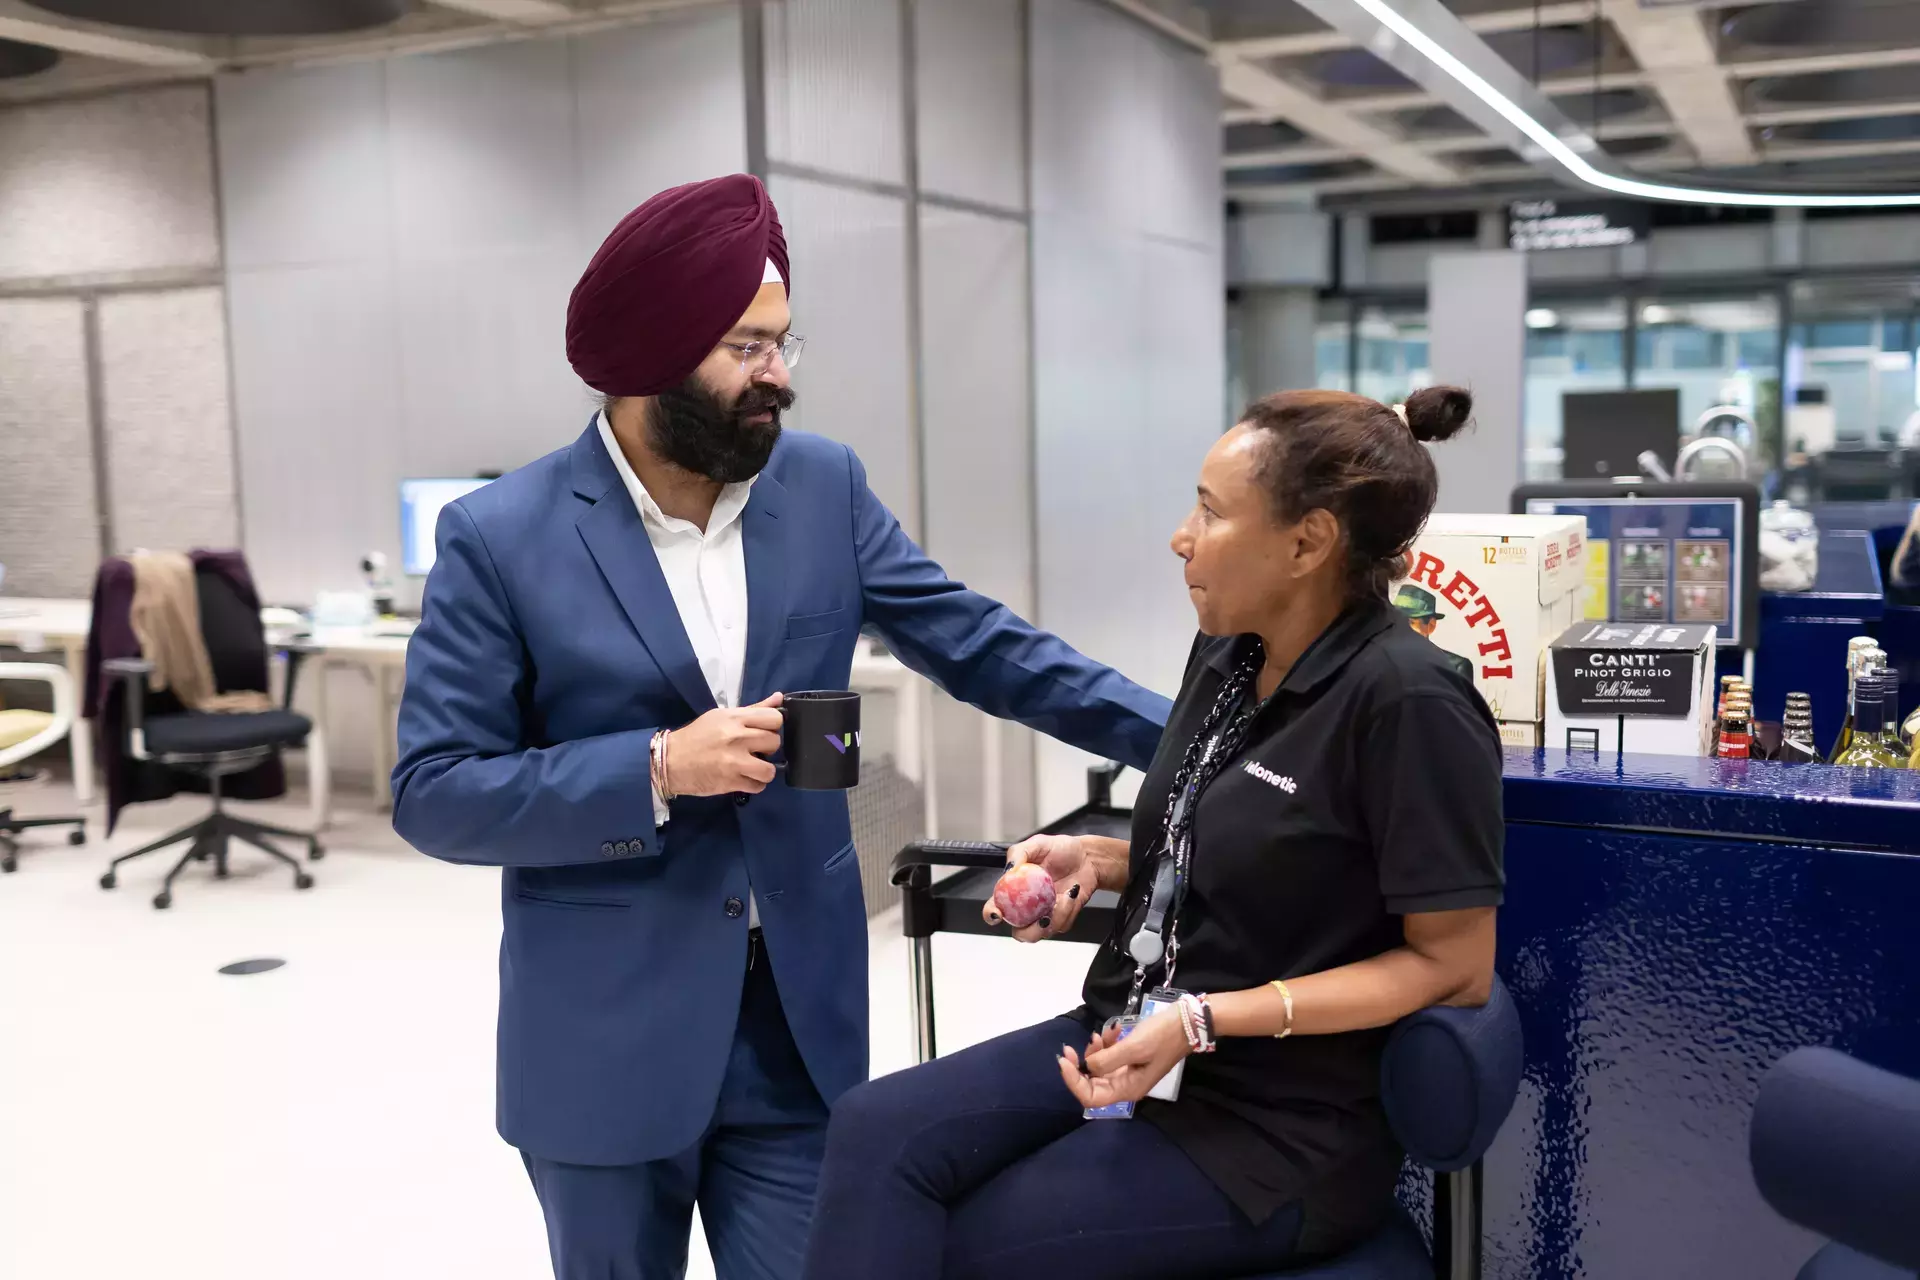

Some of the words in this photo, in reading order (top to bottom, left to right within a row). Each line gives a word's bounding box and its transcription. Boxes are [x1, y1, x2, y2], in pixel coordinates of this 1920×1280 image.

[1482, 547, 1497, 564] 12
[1499, 547, 1527, 555] BOTTLES
[1403, 548, 1513, 679] RETTI
[1574, 668, 1616, 677] PINOT
[1621, 667, 1671, 677] GRIGIO
[1595, 680, 1620, 697] Delle
[1619, 680, 1652, 697] Venezie
[1500, 729, 1524, 738] OTTLES
